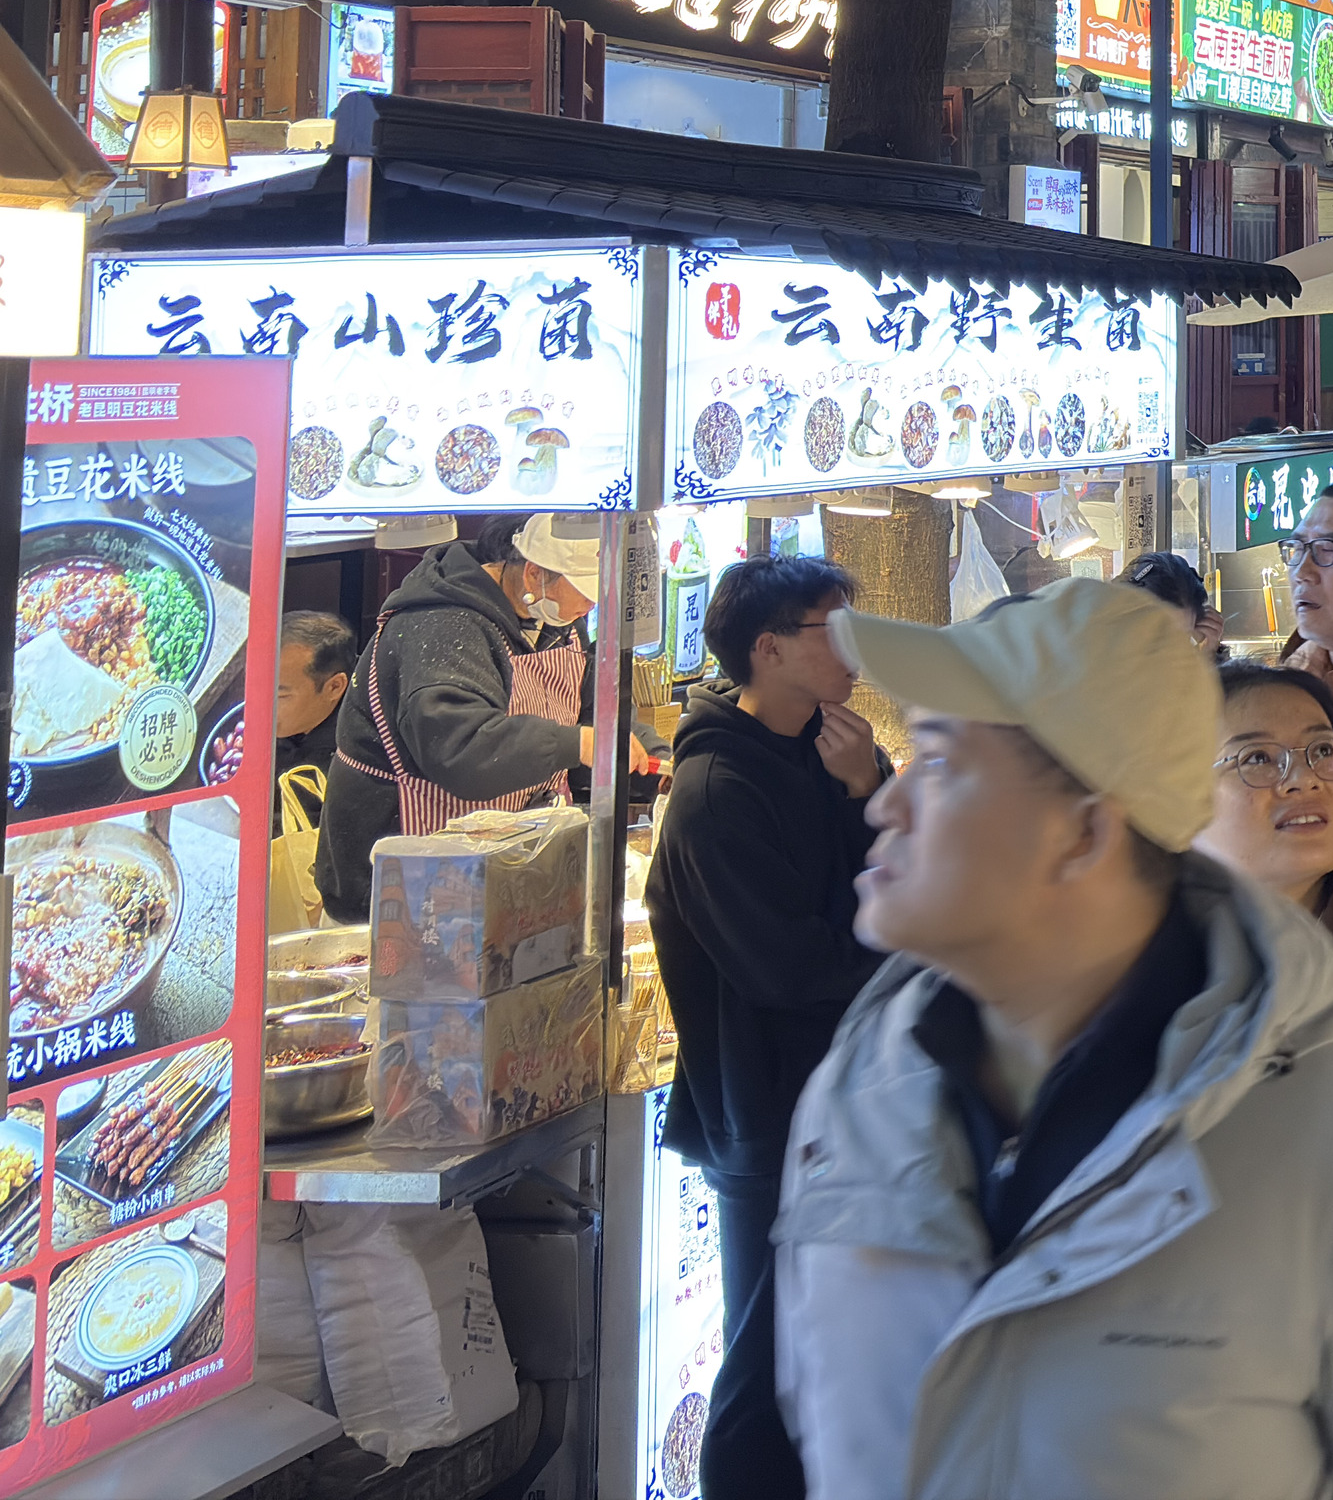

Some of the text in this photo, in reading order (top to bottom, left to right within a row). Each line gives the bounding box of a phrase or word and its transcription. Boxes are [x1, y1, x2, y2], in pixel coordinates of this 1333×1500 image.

[1194, 18, 1294, 83] 云南野生菌饭
[1195, 67, 1292, 114] 每一口都是自然之鲜
[147, 277, 593, 363] 云南山珍菌
[772, 281, 1142, 353] 云南野生菌
[78, 400, 178, 418] 老昆明豆花米线
[79, 386, 136, 398] SINCE1984
[140, 708, 178, 739] 招牌
[139, 736, 176, 765] 必点
[130, 757, 183, 785] DESHENGQIAO
[103, 1348, 172, 1398] 爽口冰三鲜
